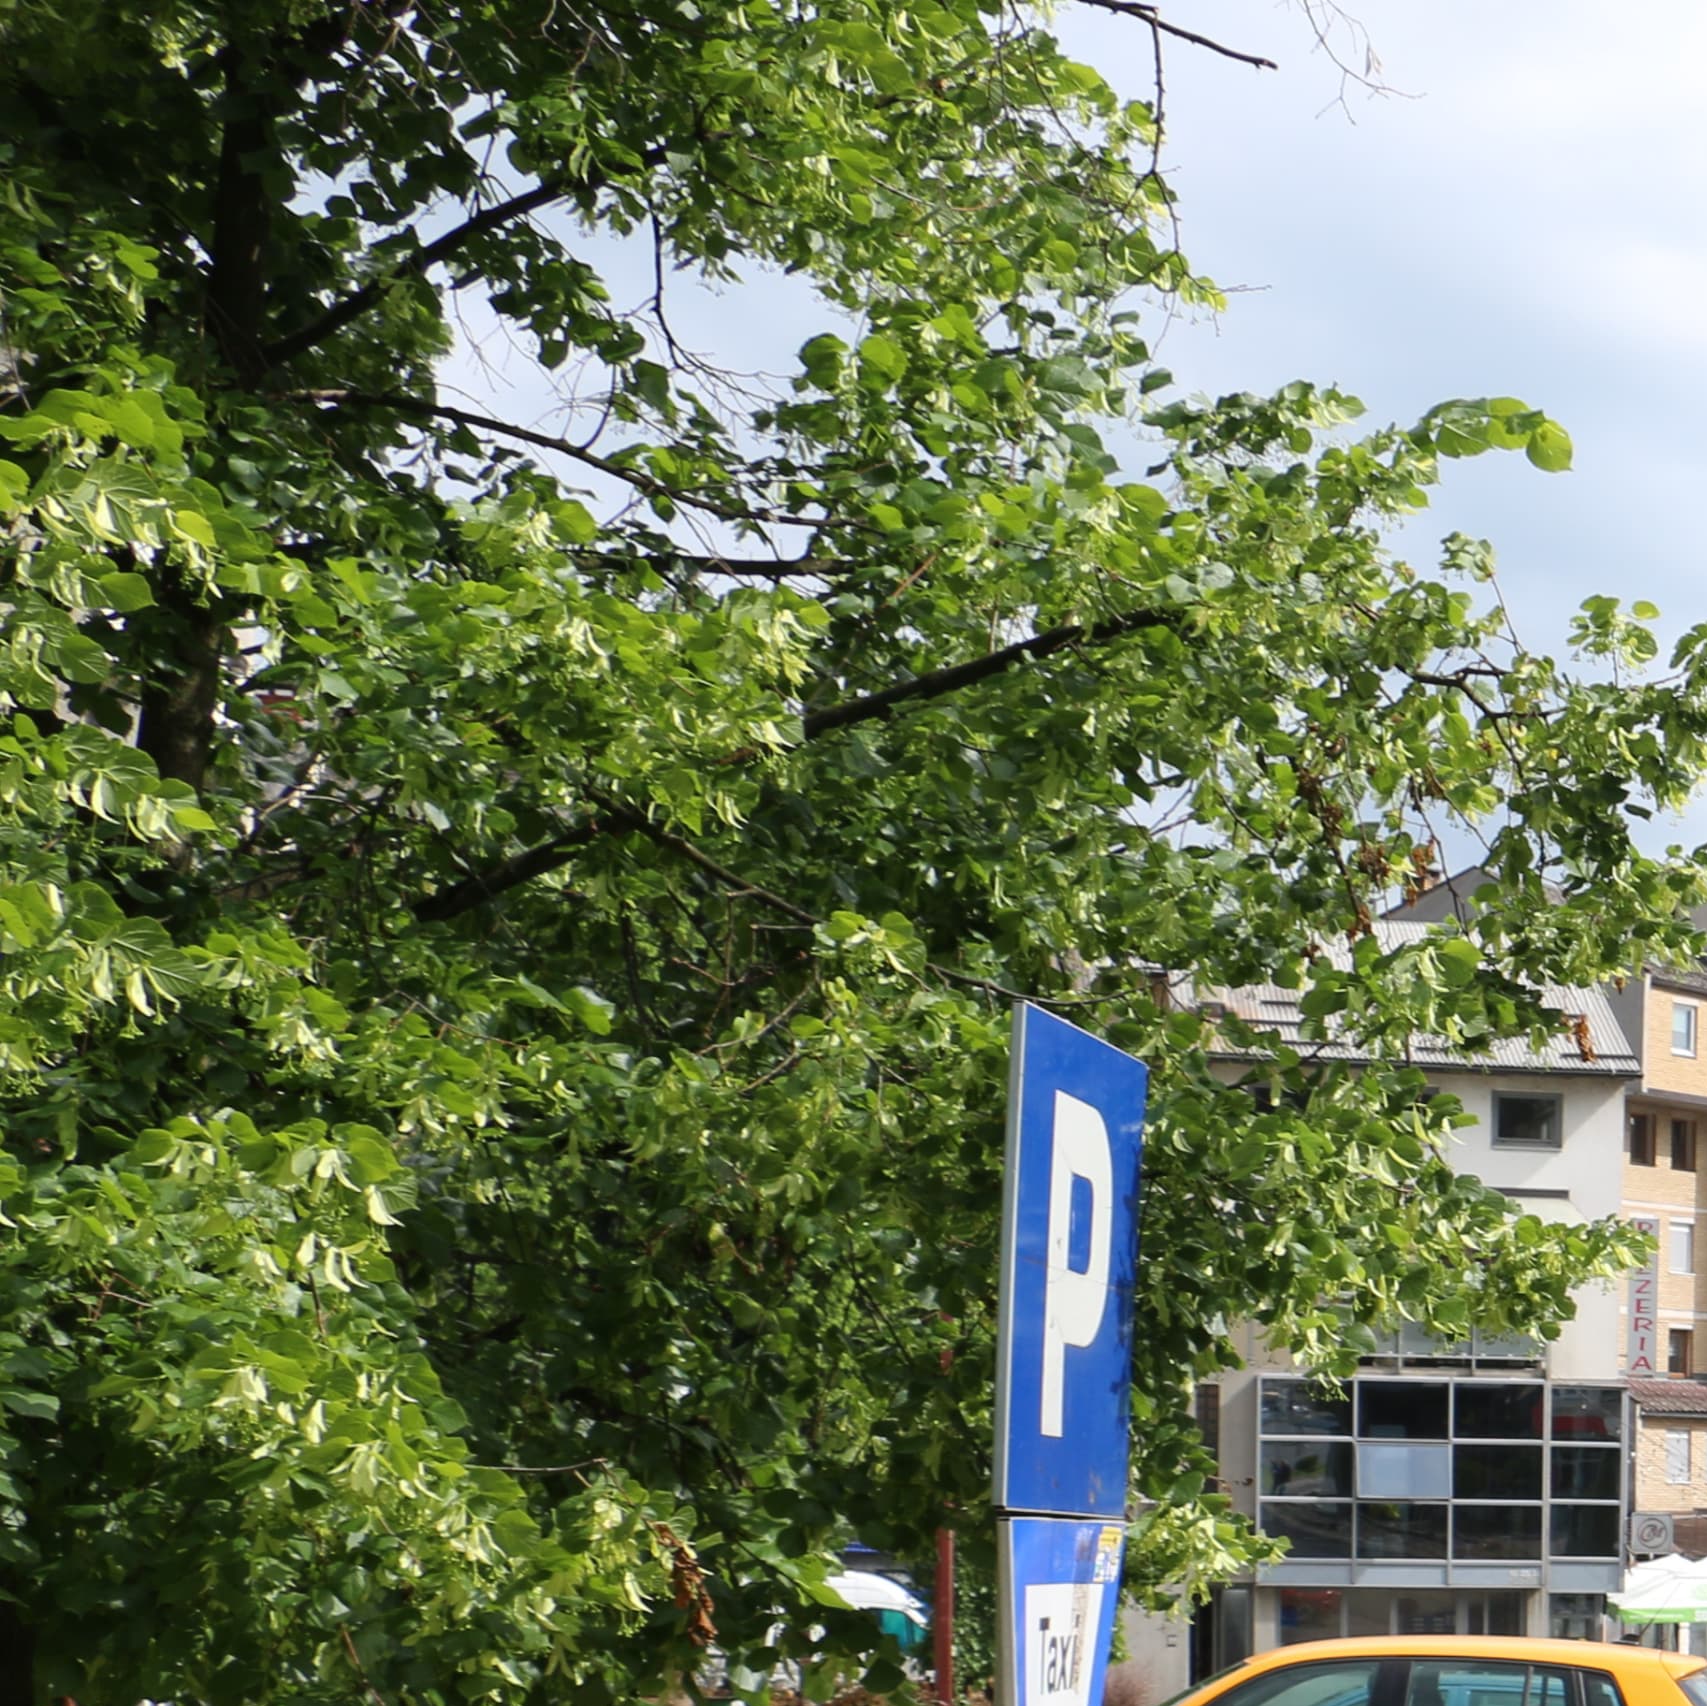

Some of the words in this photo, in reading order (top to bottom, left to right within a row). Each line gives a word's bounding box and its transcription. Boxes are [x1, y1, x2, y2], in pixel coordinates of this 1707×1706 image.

[1040, 1088, 1113, 1438] P
[1631, 1221, 1654, 1371] PZERIA
[1039, 1613, 1081, 1695] Taxi
